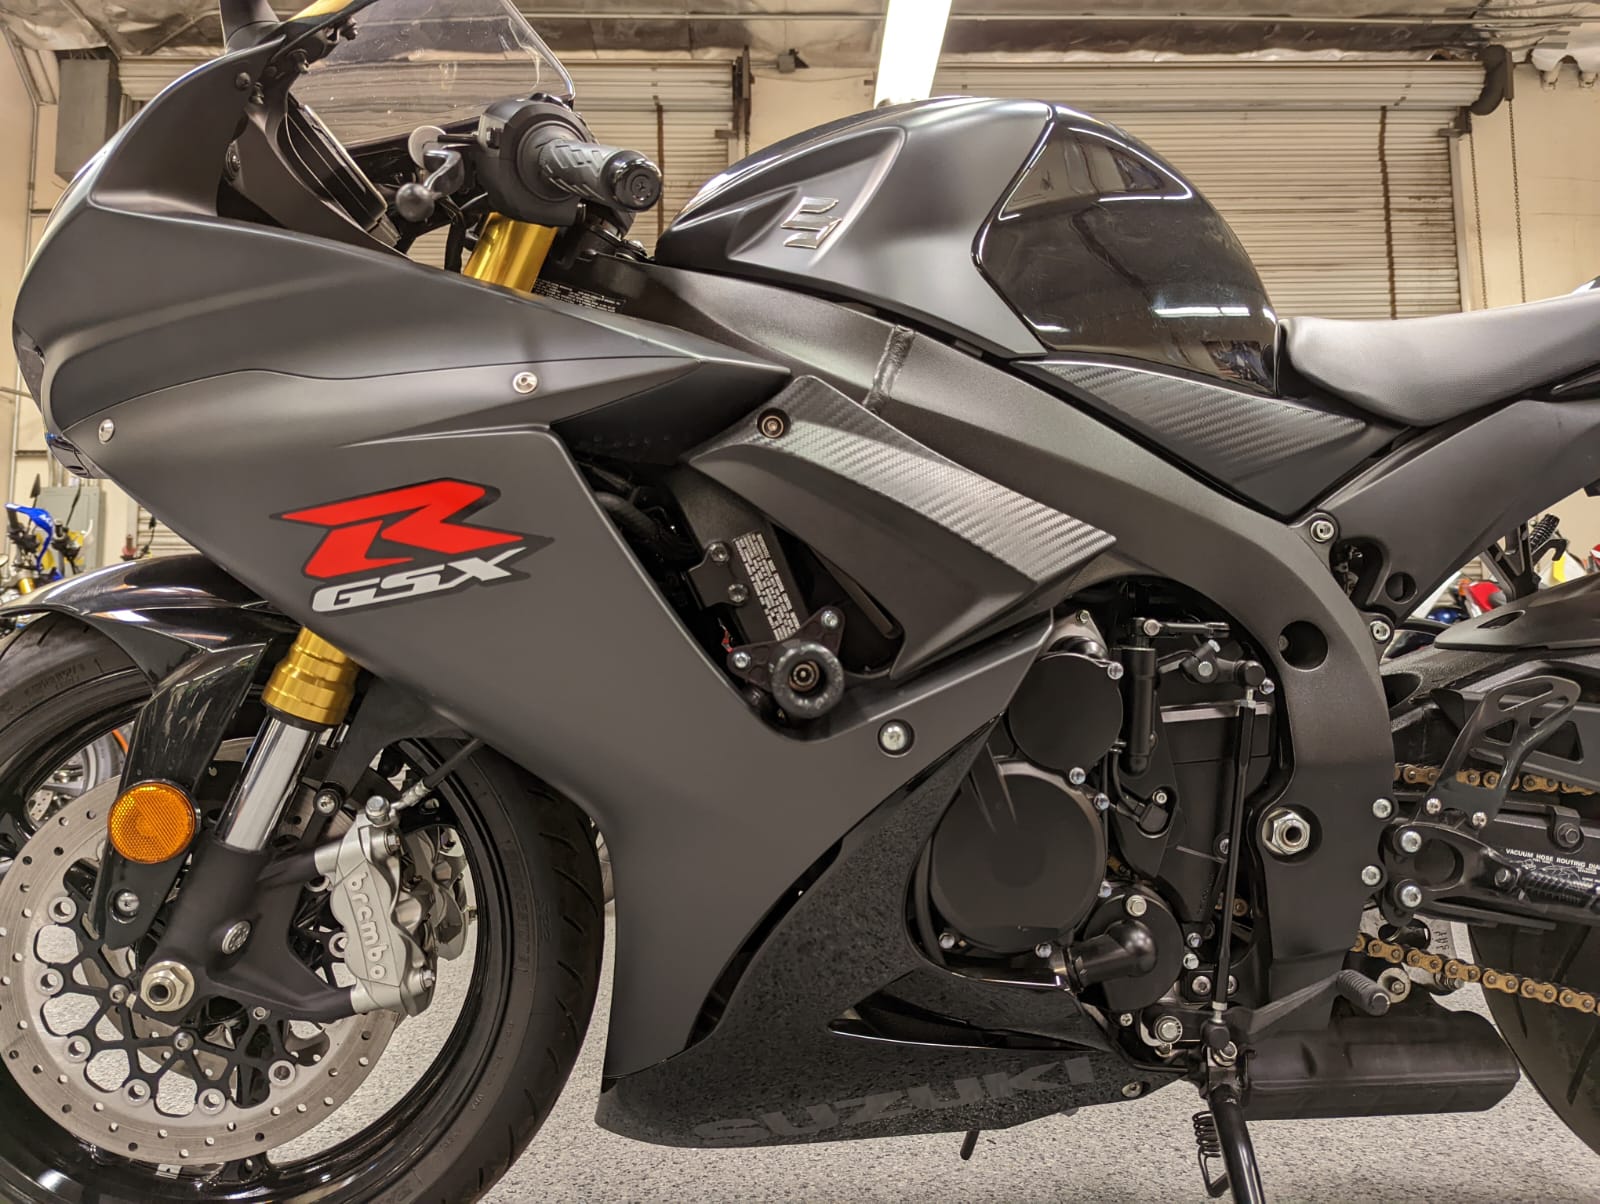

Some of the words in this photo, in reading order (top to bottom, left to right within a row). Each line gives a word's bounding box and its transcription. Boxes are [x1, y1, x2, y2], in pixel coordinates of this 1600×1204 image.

[311, 546, 528, 613] GSX
[1505, 848, 1534, 858] VACUUM
[1536, 854, 1554, 862] HOSE
[1556, 857, 1586, 868] ROUTING
[349, 871, 389, 980] brembo
[694, 1056, 1096, 1145] SUZUKI
